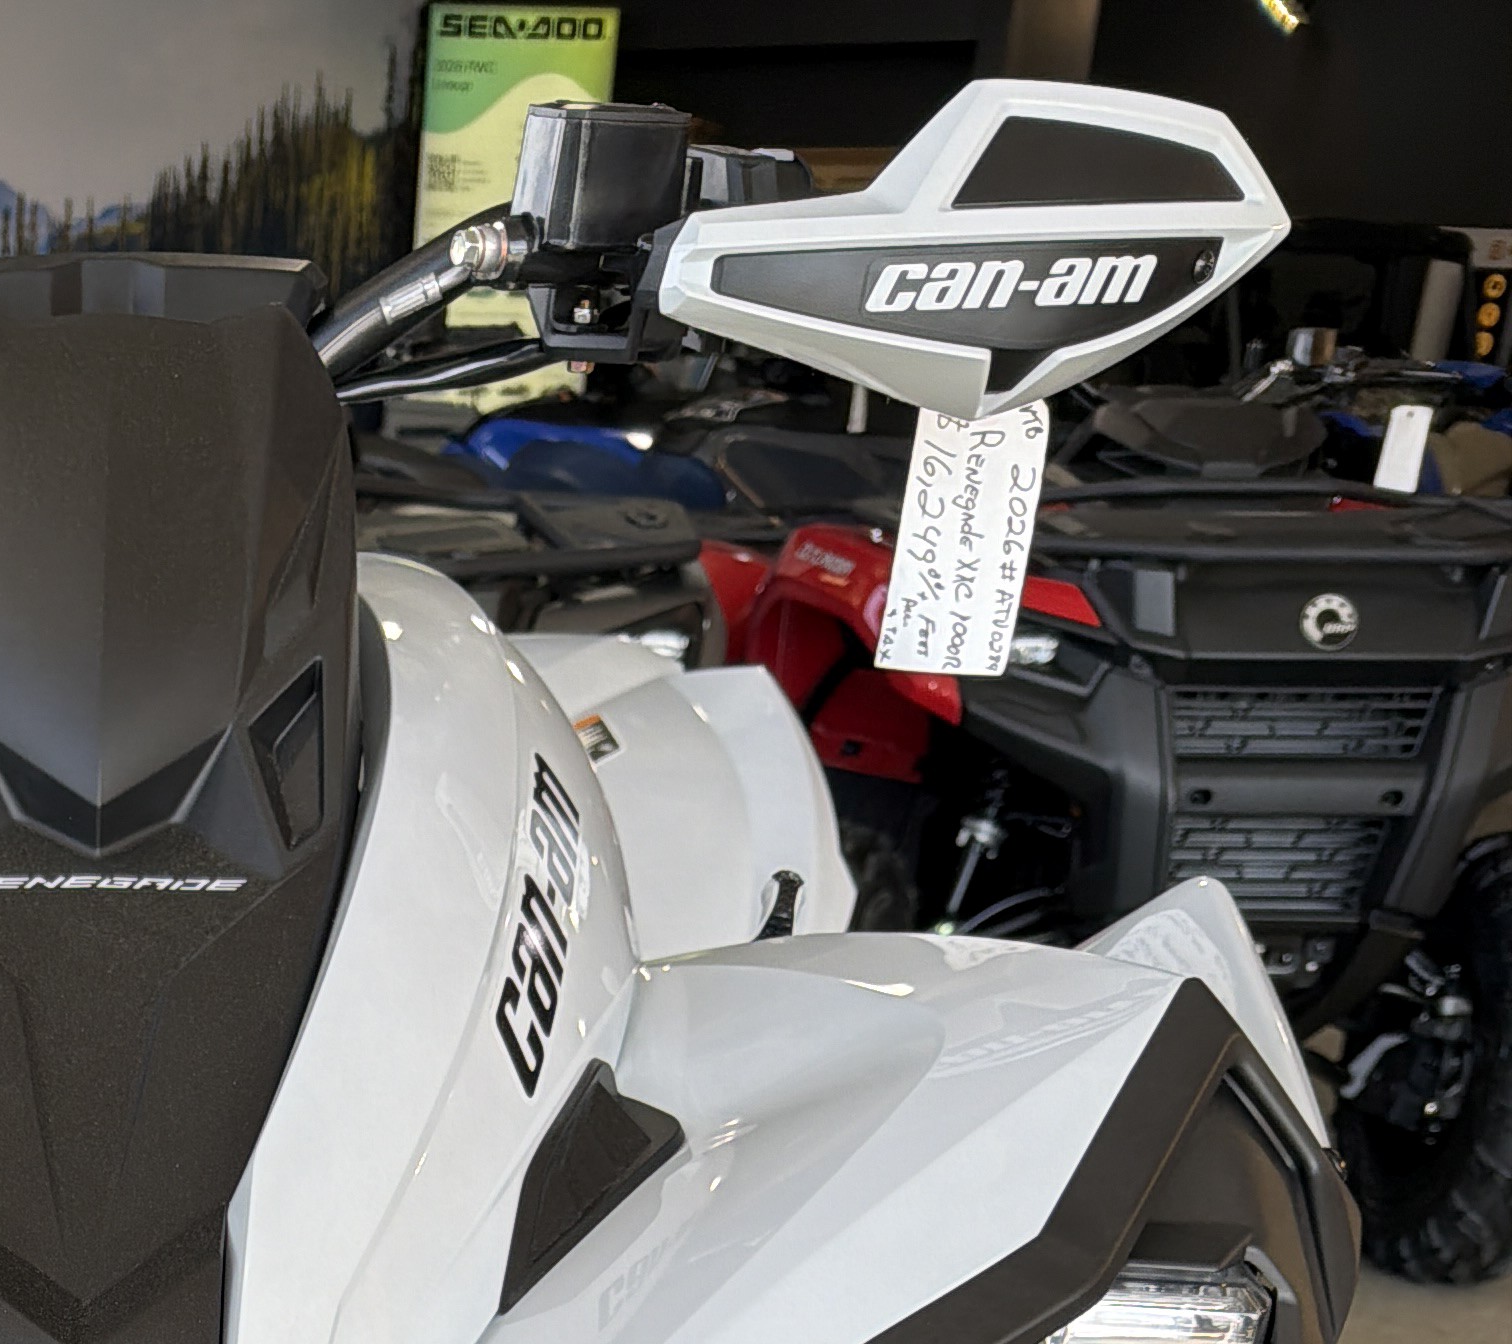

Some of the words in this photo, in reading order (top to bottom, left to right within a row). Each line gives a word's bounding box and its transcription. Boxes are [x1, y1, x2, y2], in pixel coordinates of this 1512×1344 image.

[865, 254, 1158, 313] can-am
[1003, 464, 1036, 556] 2026
[495, 751, 579, 1098] can-am
